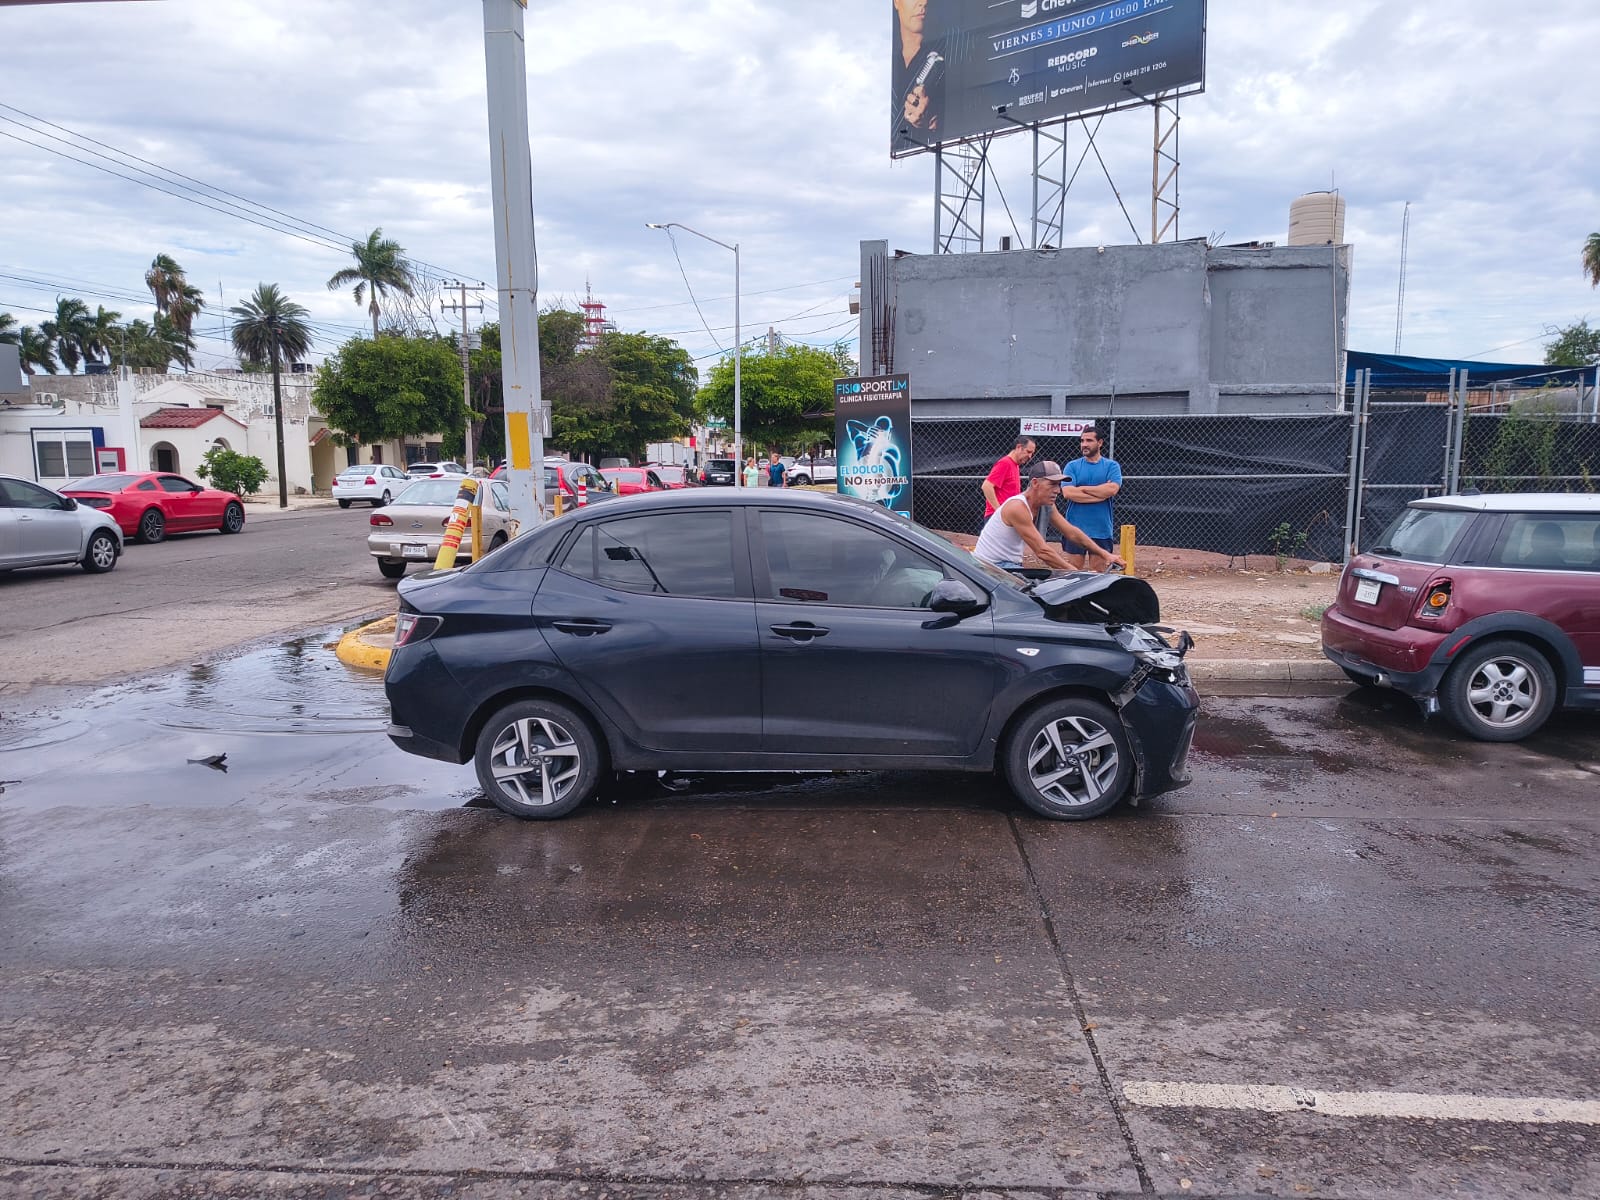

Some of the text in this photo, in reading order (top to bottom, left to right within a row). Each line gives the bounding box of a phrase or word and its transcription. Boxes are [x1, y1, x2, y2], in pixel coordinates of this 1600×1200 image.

[993, 27, 1043, 51] VIERNES
[1047, 27, 1053, 37] 5
[1055, 15, 1096, 38] JUNIO
[1109, 2, 1139, 19] 10:00
[1047, 47, 1098, 67] REDCORD
[1057, 59, 1087, 72] MUSIC
[863, 392, 902, 401] FISIOTERAPIA
[841, 464, 885, 475] EL DOLOR
[844, 475, 863, 486] NO
[874, 476, 908, 485] NORMAL
